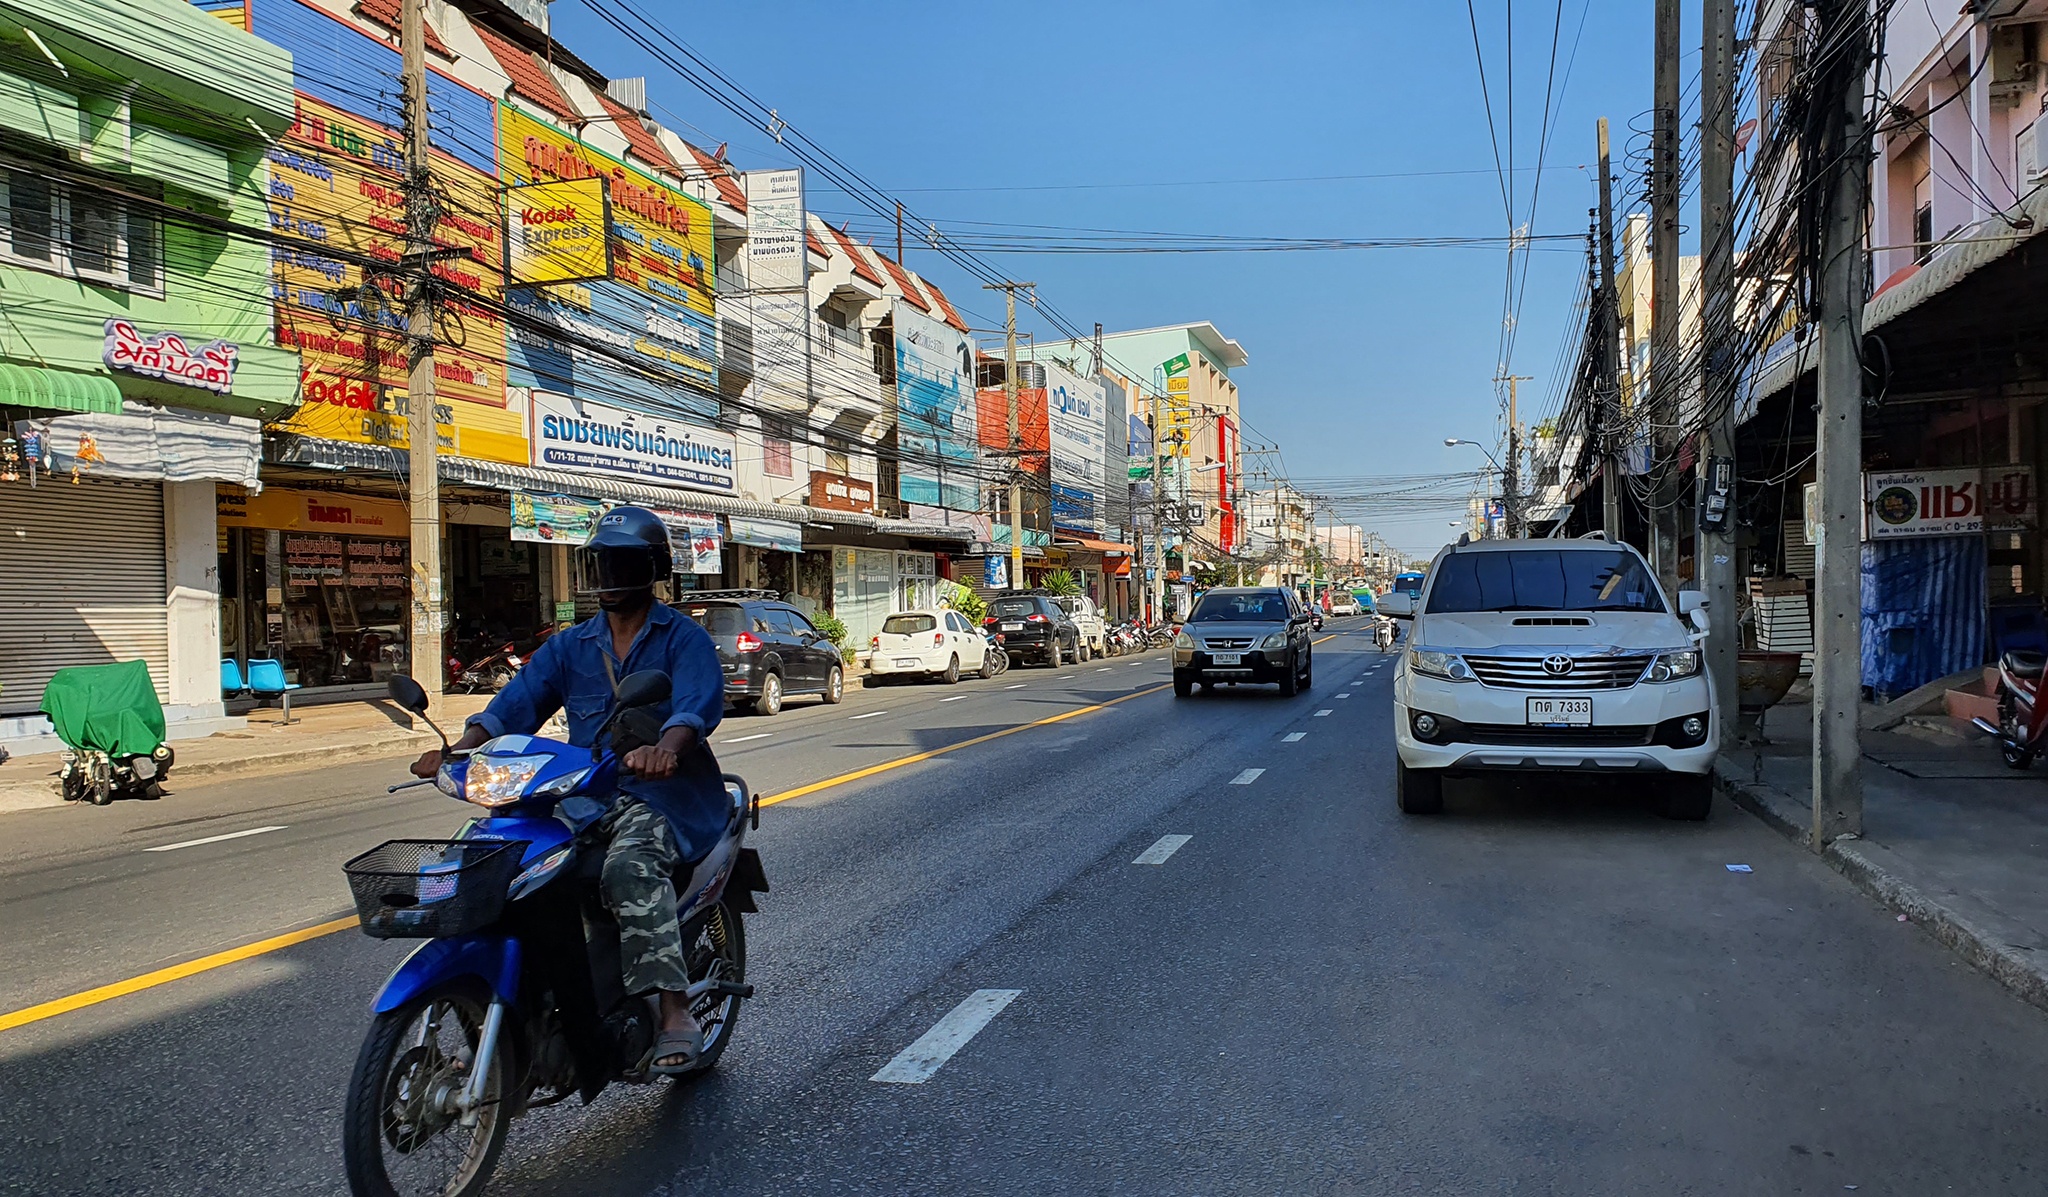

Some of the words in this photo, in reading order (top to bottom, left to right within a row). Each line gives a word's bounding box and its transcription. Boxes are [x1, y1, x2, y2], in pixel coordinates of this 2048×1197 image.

[521, 203, 576, 226] Kodak
[521, 226, 589, 246] Express
[753, 233, 795, 245] ตรายางด่วน
[752, 244, 795, 256] นามบัตรด่วน
[549, 451, 576, 462] 1/71-72
[1535, 701, 1552, 713] กต
[1558, 701, 1589, 713] 7333
